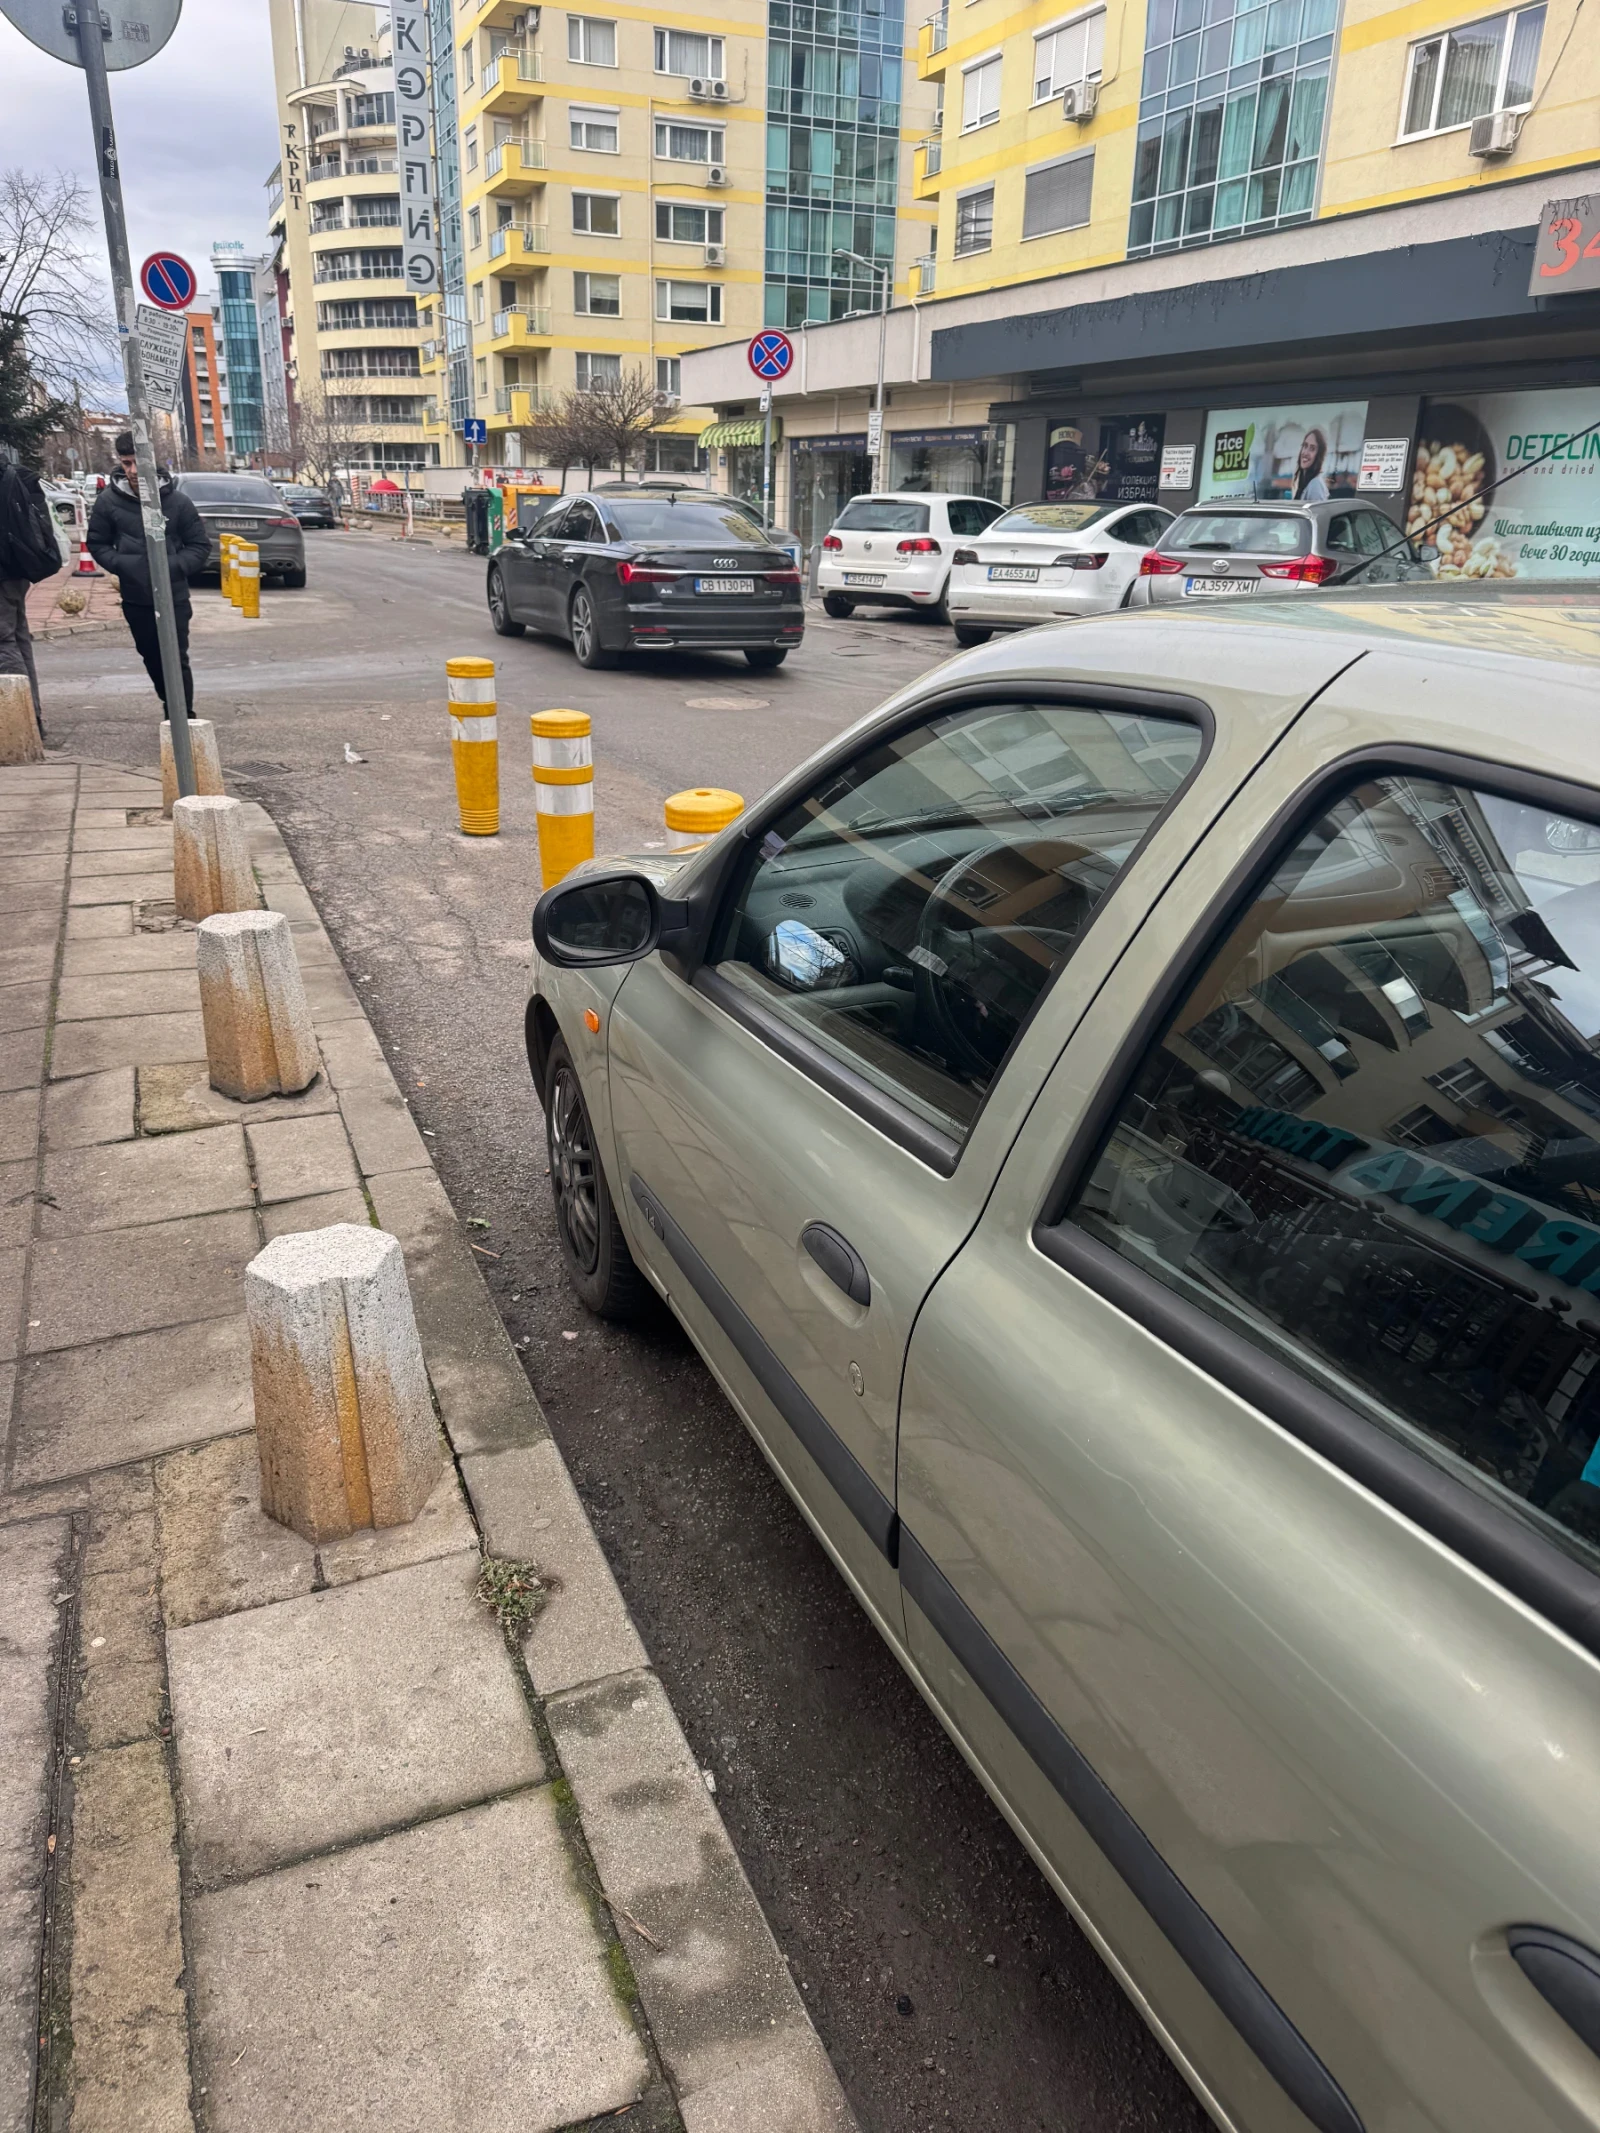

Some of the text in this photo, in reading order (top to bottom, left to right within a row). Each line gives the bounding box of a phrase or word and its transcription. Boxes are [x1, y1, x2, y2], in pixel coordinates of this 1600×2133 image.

[285, 143, 303, 211] КРИТ
[140, 340, 178, 357] СЛУЖЕБЕН
[141, 350, 179, 368] БОНАМЕНТ
[1216, 434, 1244, 452] rice
[1502, 463, 1595, 475] nu and dried
[1121, 475, 1157, 486] КОЛЕКЦИЯ
[1494, 519, 1584, 538] Щастливият
[1520, 544, 1548, 560] вече
[1549, 544, 1568, 561] 30
[992, 568, 1036, 579] EA 4655 AA
[701, 580, 753, 591] CB 1130 PH
[1193, 579, 1251, 592] CA 3597 XM
